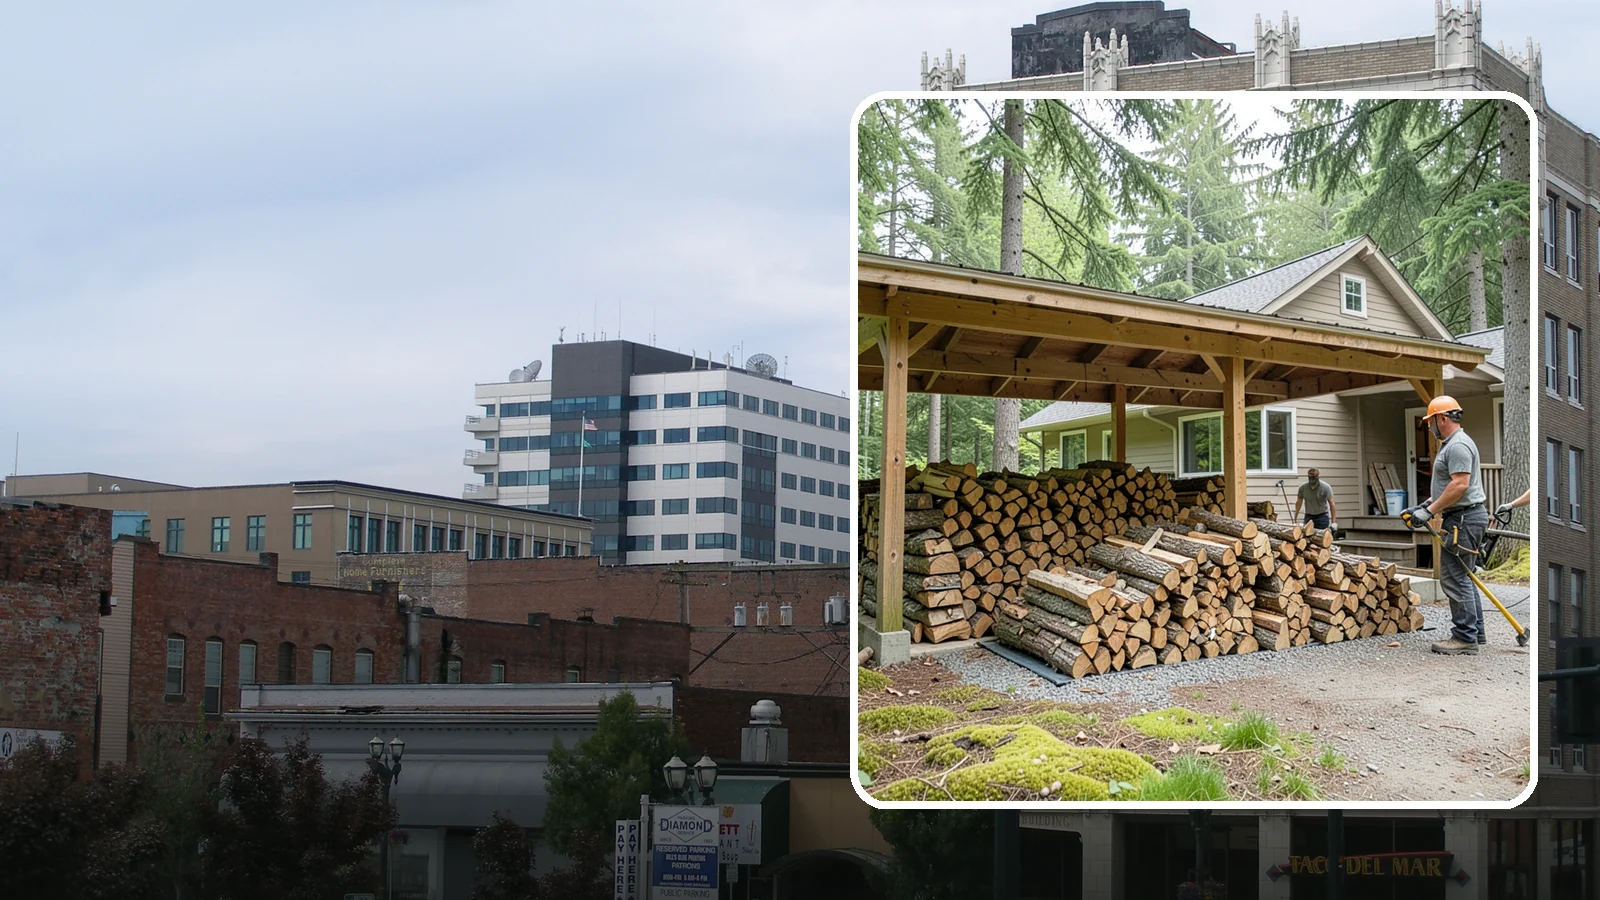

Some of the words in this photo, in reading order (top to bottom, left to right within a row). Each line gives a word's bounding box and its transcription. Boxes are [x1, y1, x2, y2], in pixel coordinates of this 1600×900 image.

[370, 566, 427, 576] Furnishers
[661, 818, 713, 832] DIAMOND
[1021, 815, 1070, 828] BUILDING
[617, 825, 625, 852] PAY
[628, 824, 637, 852] PAY
[689, 846, 716, 854] PARKING
[671, 862, 701, 870] PATRONS
[1289, 855, 1330, 874] TAC
[1346, 856, 1386, 876] DEL
[1392, 857, 1443, 877] MAR
[616, 856, 625, 894] HERE
[627, 855, 636, 894] HERE
[660, 889, 682, 897] PUBLIC
[683, 890, 710, 898] PARKING
